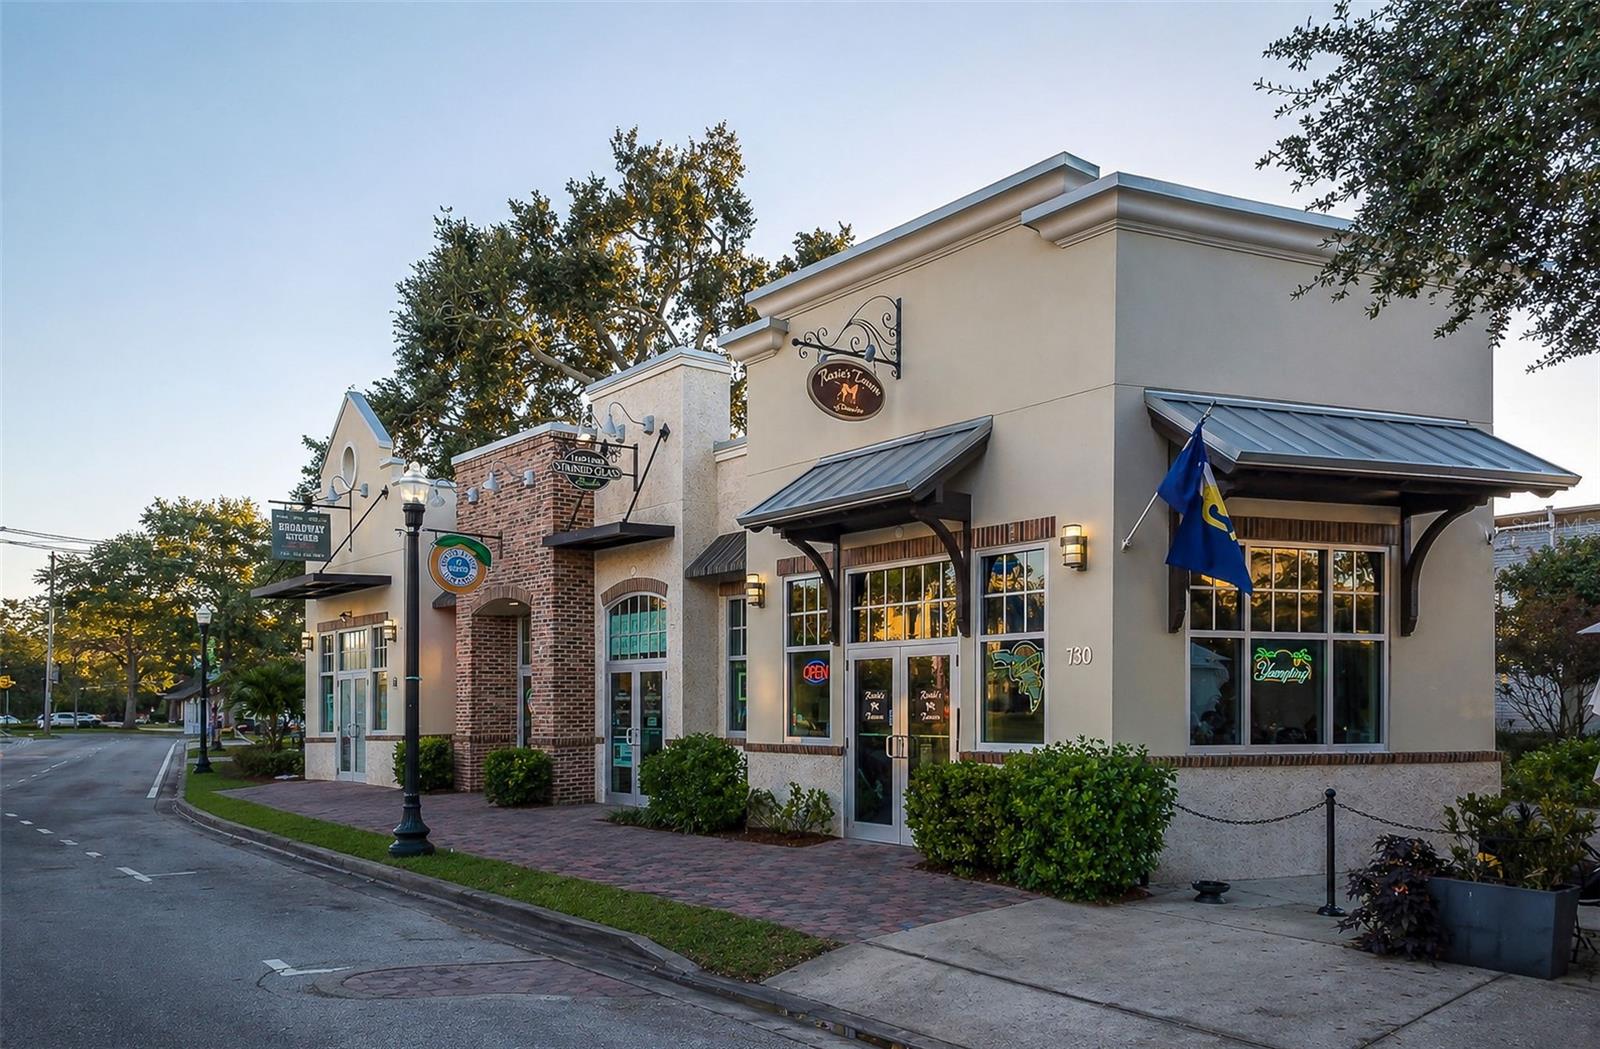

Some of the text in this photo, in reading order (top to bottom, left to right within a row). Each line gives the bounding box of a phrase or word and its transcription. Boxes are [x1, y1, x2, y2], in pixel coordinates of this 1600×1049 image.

[278, 522, 325, 534] BROADWAY
[1066, 646, 1092, 665] 730
[803, 664, 829, 679] OPEN
